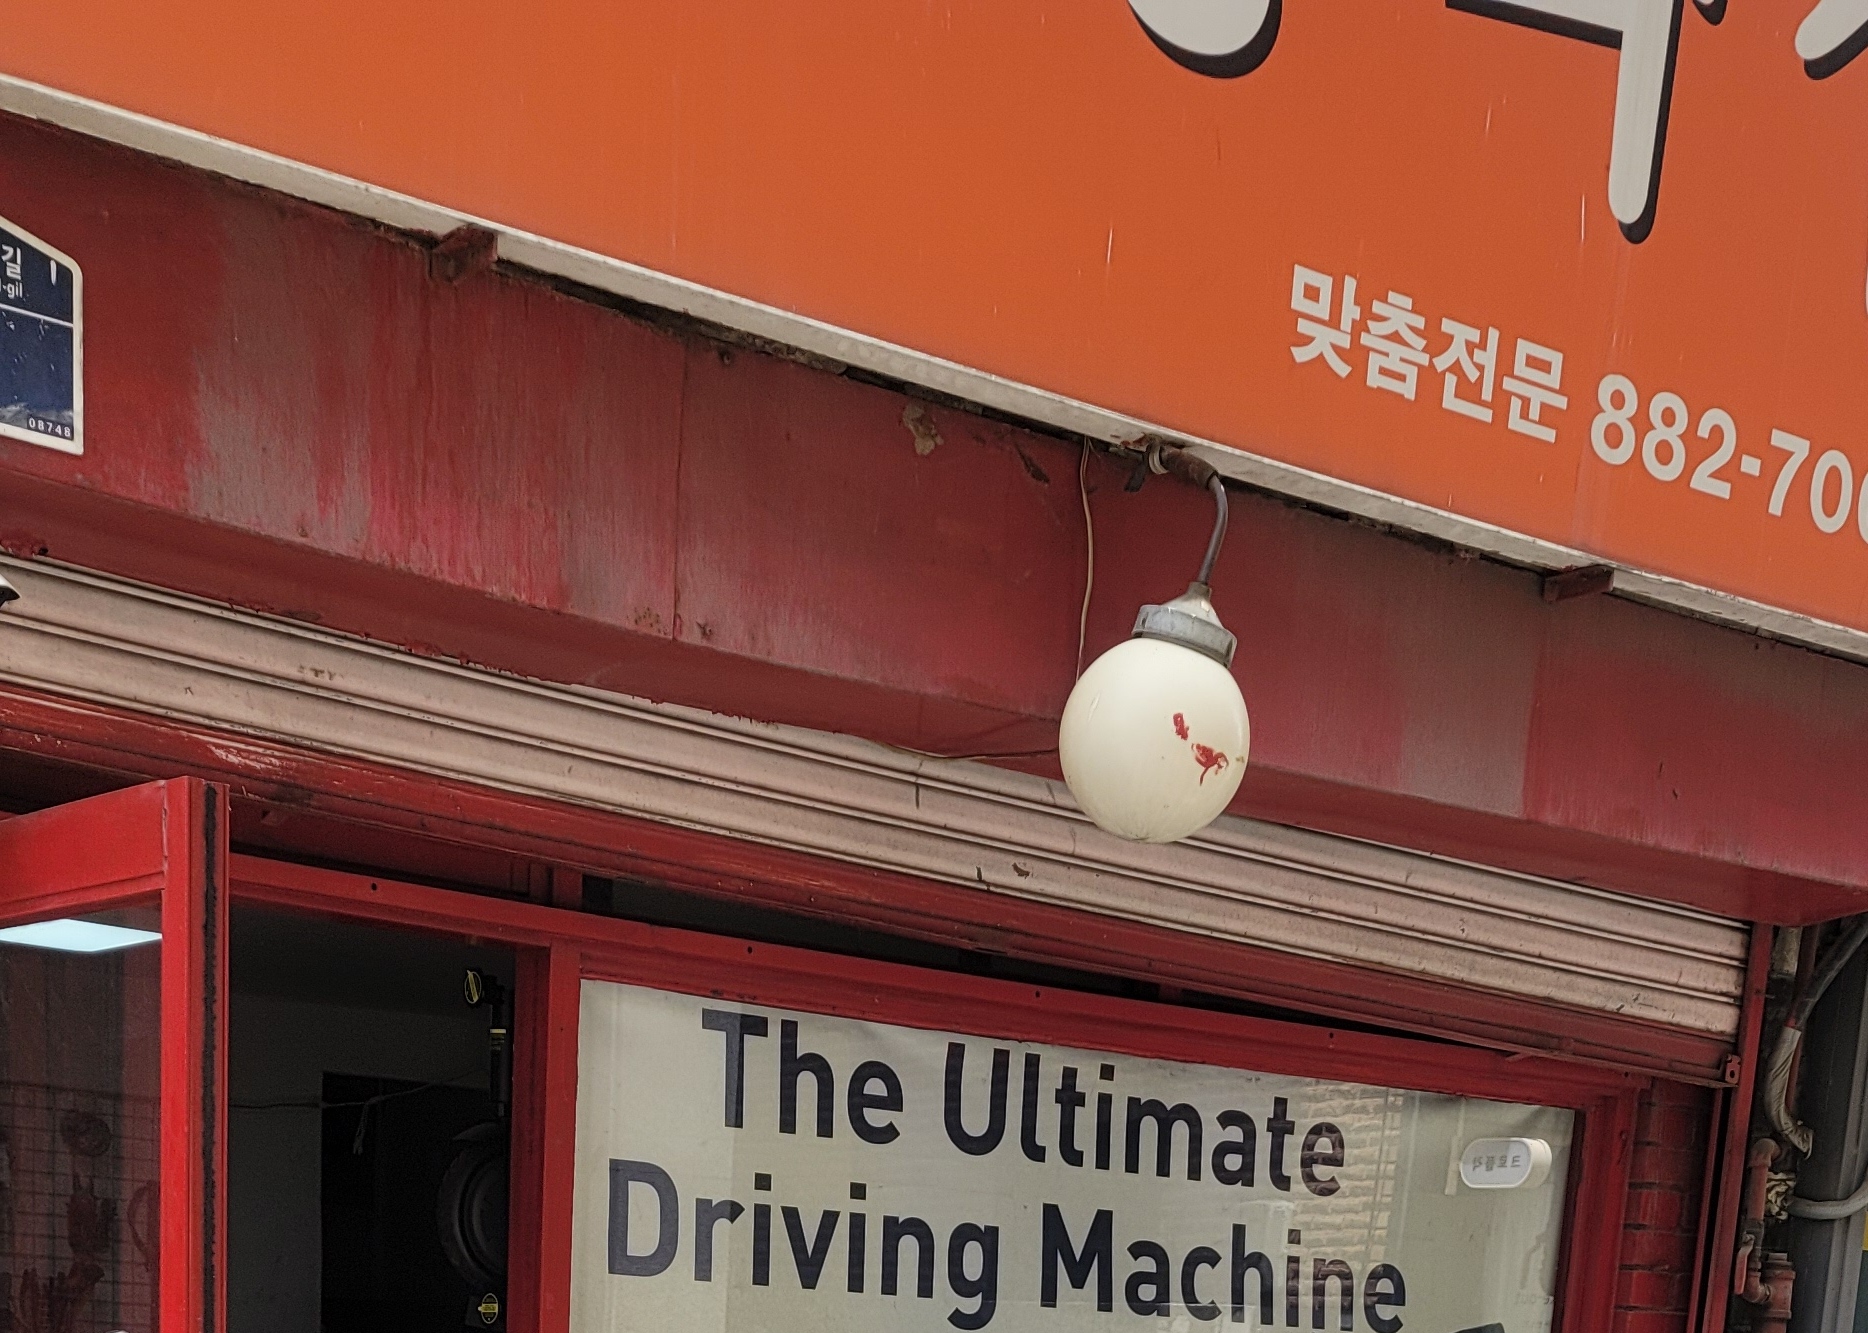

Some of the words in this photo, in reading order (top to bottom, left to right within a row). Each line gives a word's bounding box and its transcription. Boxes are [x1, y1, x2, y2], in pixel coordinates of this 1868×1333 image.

[29, 417, 71, 439] 08748
[1291, 263, 1568, 443] 맞춤전문
[1591, 375, 1868, 543] 882-70
[702, 1008, 903, 1144] The
[944, 1042, 1344, 1196] Ultimate
[608, 1159, 999, 1330] Driving
